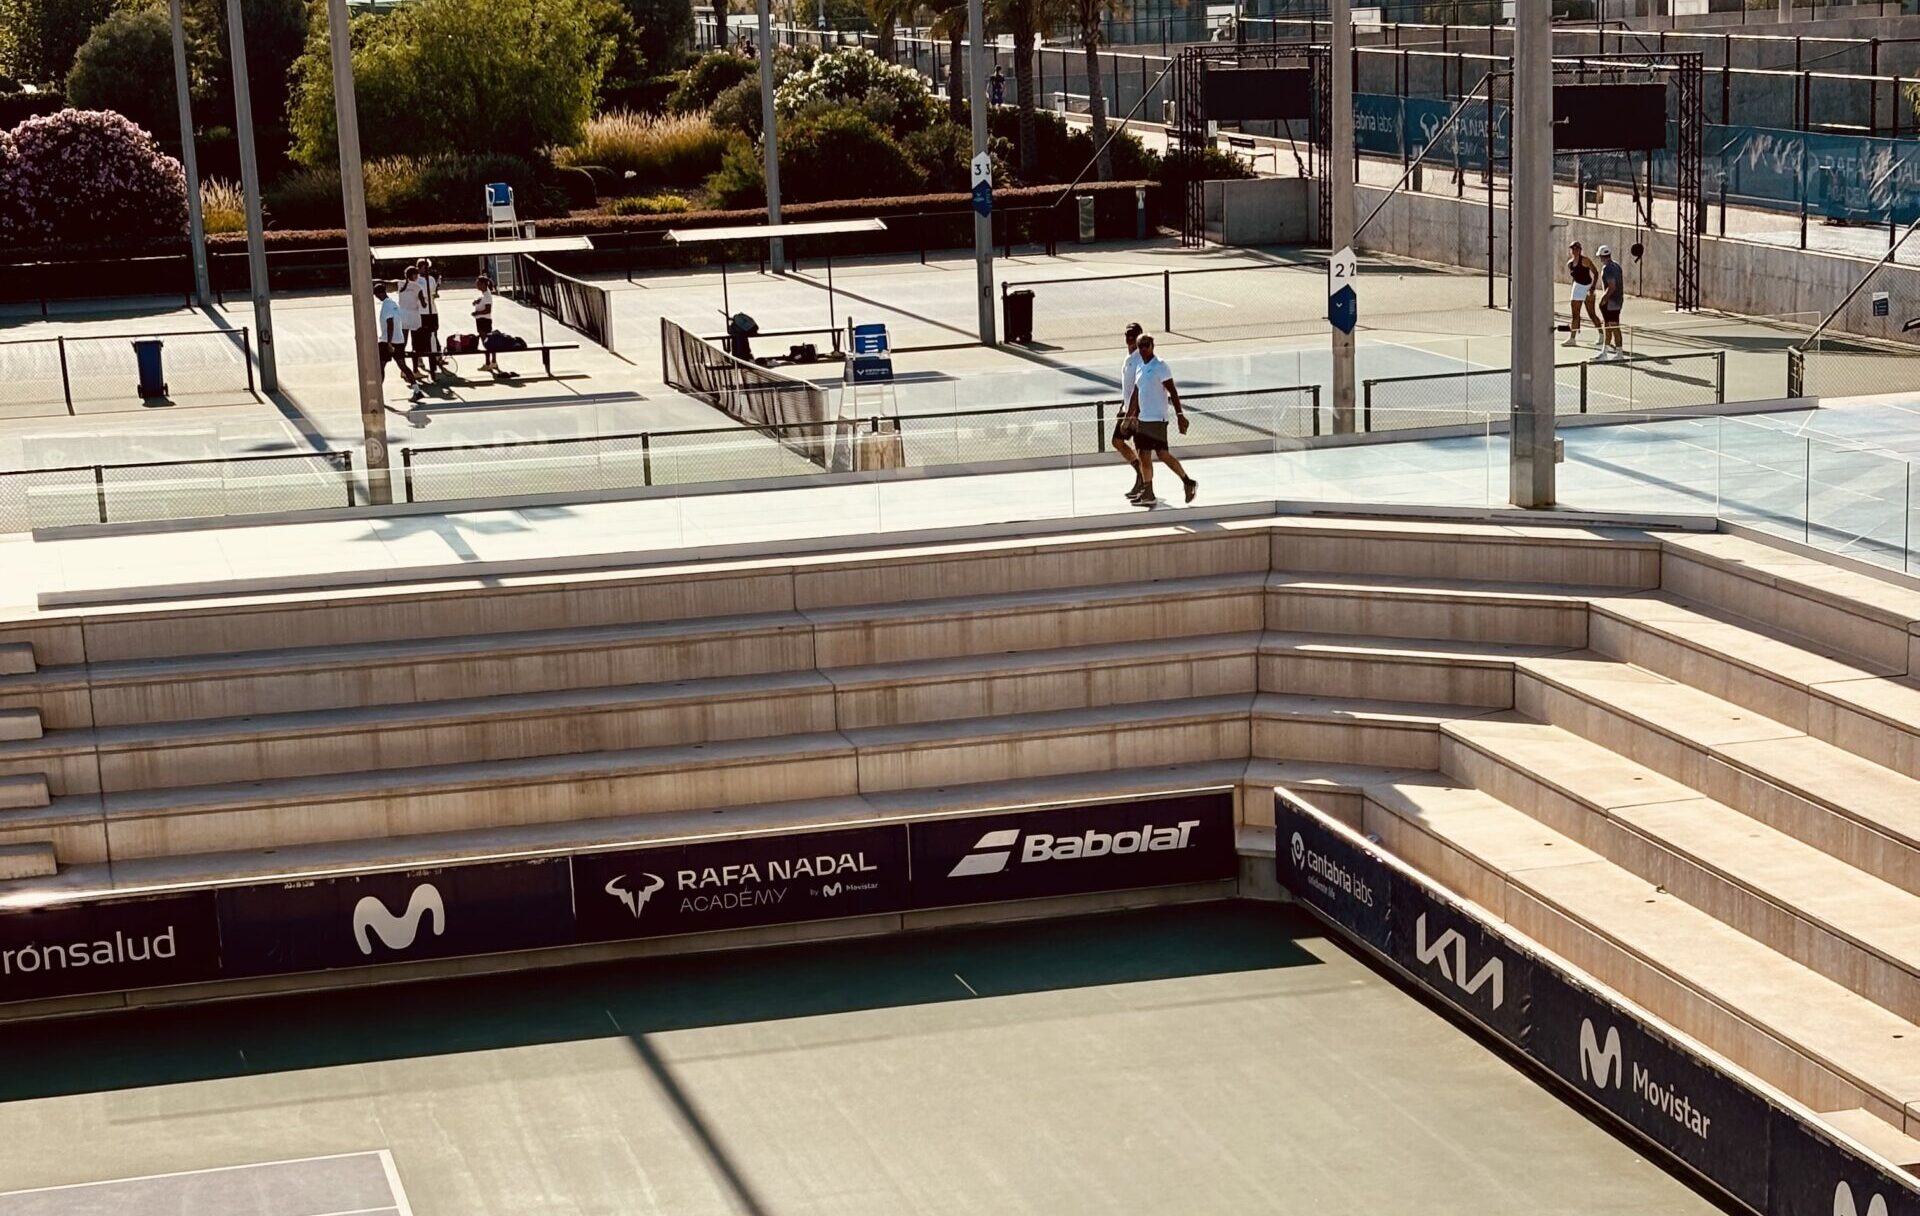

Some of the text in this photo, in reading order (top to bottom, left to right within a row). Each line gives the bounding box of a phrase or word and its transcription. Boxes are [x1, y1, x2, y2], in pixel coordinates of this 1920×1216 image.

[1335, 263, 1345, 278] 2
[677, 851, 878, 891] RAFA NADAL
[1307, 850, 1351, 893] cantabria
[1353, 873, 1374, 908] labs
[680, 887, 787, 913] ACADEMY
[1632, 1062, 1711, 1140] Movistar
